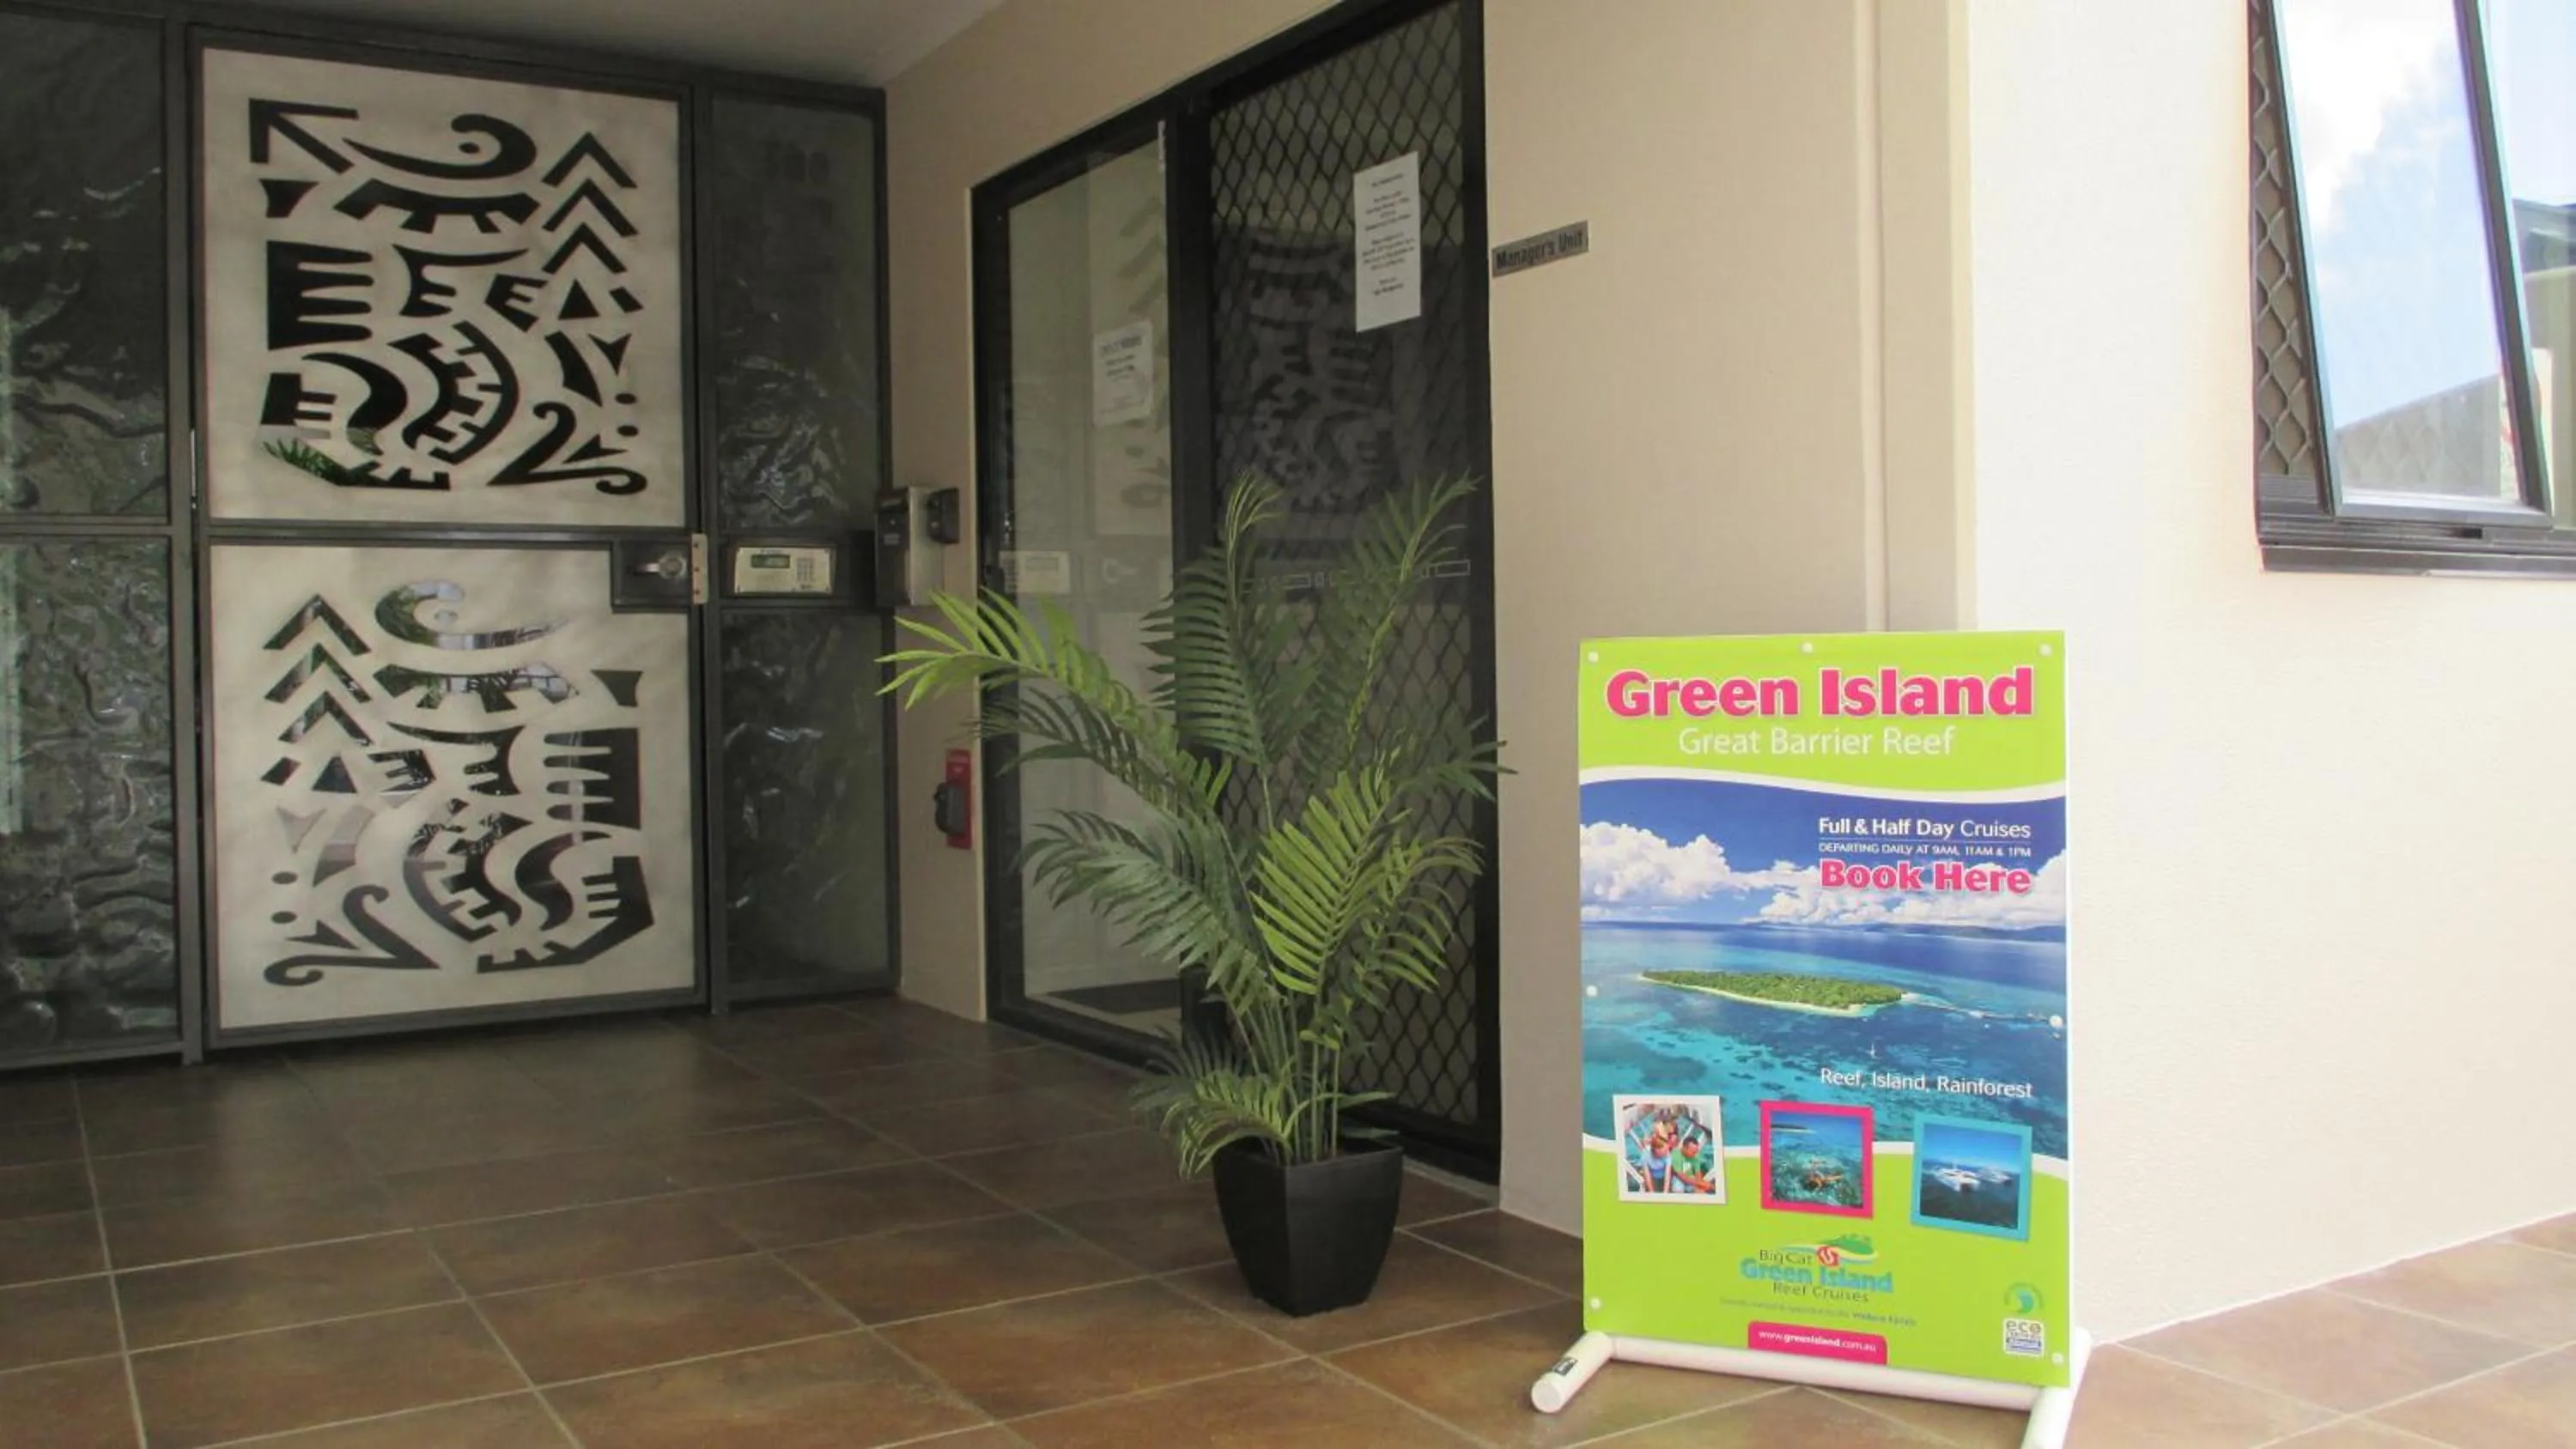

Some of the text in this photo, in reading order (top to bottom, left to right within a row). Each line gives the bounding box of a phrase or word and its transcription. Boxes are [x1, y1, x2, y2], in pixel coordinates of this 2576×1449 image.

[1496, 228, 1583, 270] Manager's Unit
[1605, 667, 2033, 718] Green Island
[1679, 726, 1956, 755] Great Barrier Reef
[1819, 817, 2032, 840] Full & Half Day Cruises
[1819, 842, 1880, 854] DEPARTING
[1882, 844, 1912, 856] DAILY
[1916, 845, 1929, 855] AT
[1965, 846, 1994, 857] 11AM
[1996, 846, 2004, 857] &
[2008, 846, 2032, 858] 1PM
[1820, 858, 2032, 894] Book Here
[1820, 1067, 2033, 1098] Reef, Island, Rainforest
[1759, 1249, 1813, 1265] Big Cat
[1740, 1258, 1893, 1294] Green Island
[1773, 1282, 1869, 1303] Reef Cruises
[1759, 1330, 1877, 1353] www.greenisland.com.au
